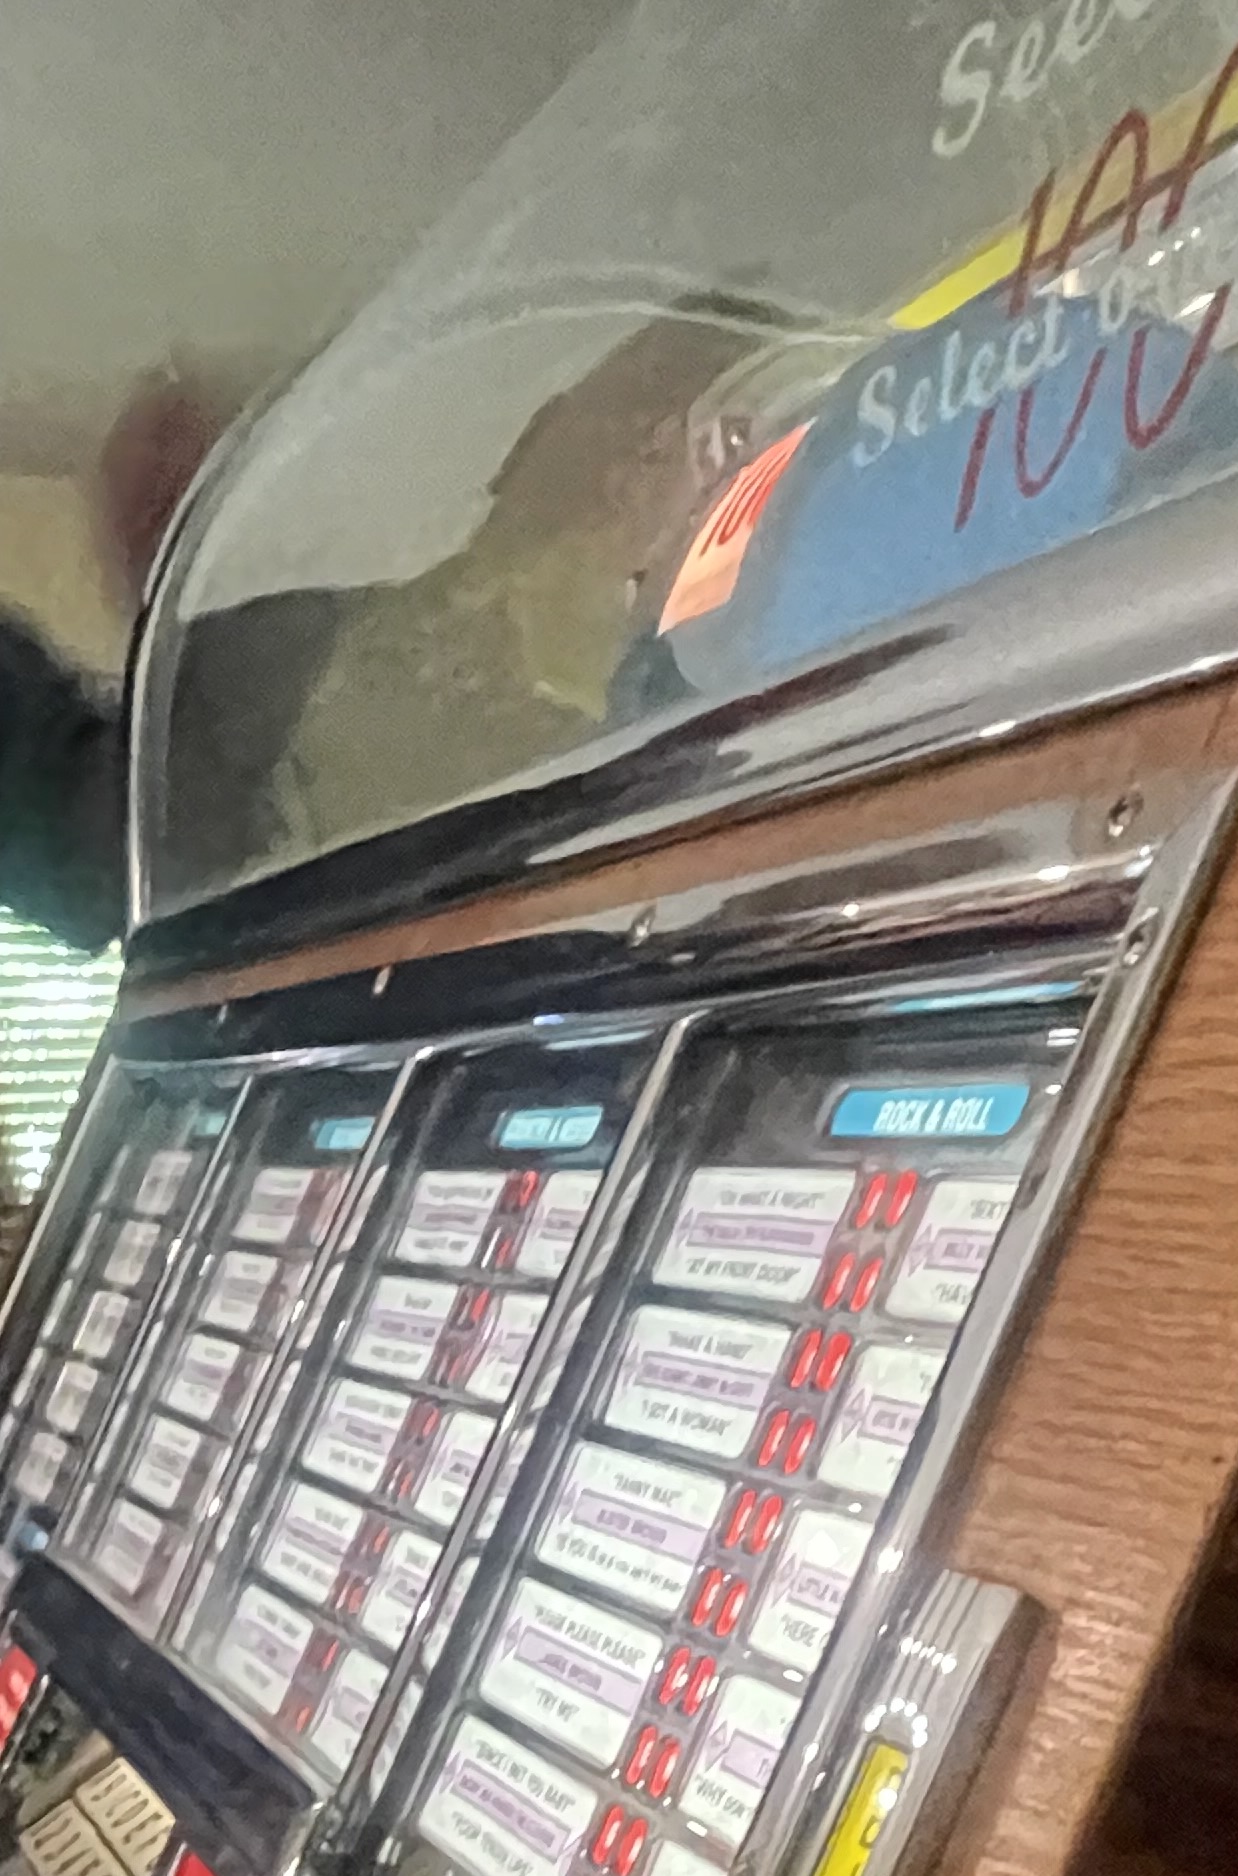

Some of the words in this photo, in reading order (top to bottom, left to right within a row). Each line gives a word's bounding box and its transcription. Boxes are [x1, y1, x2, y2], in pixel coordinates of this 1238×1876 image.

[872, 1099, 933, 1132] ROCK
[927, 1100, 942, 1130] &
[942, 1097, 992, 1131] ROLL
